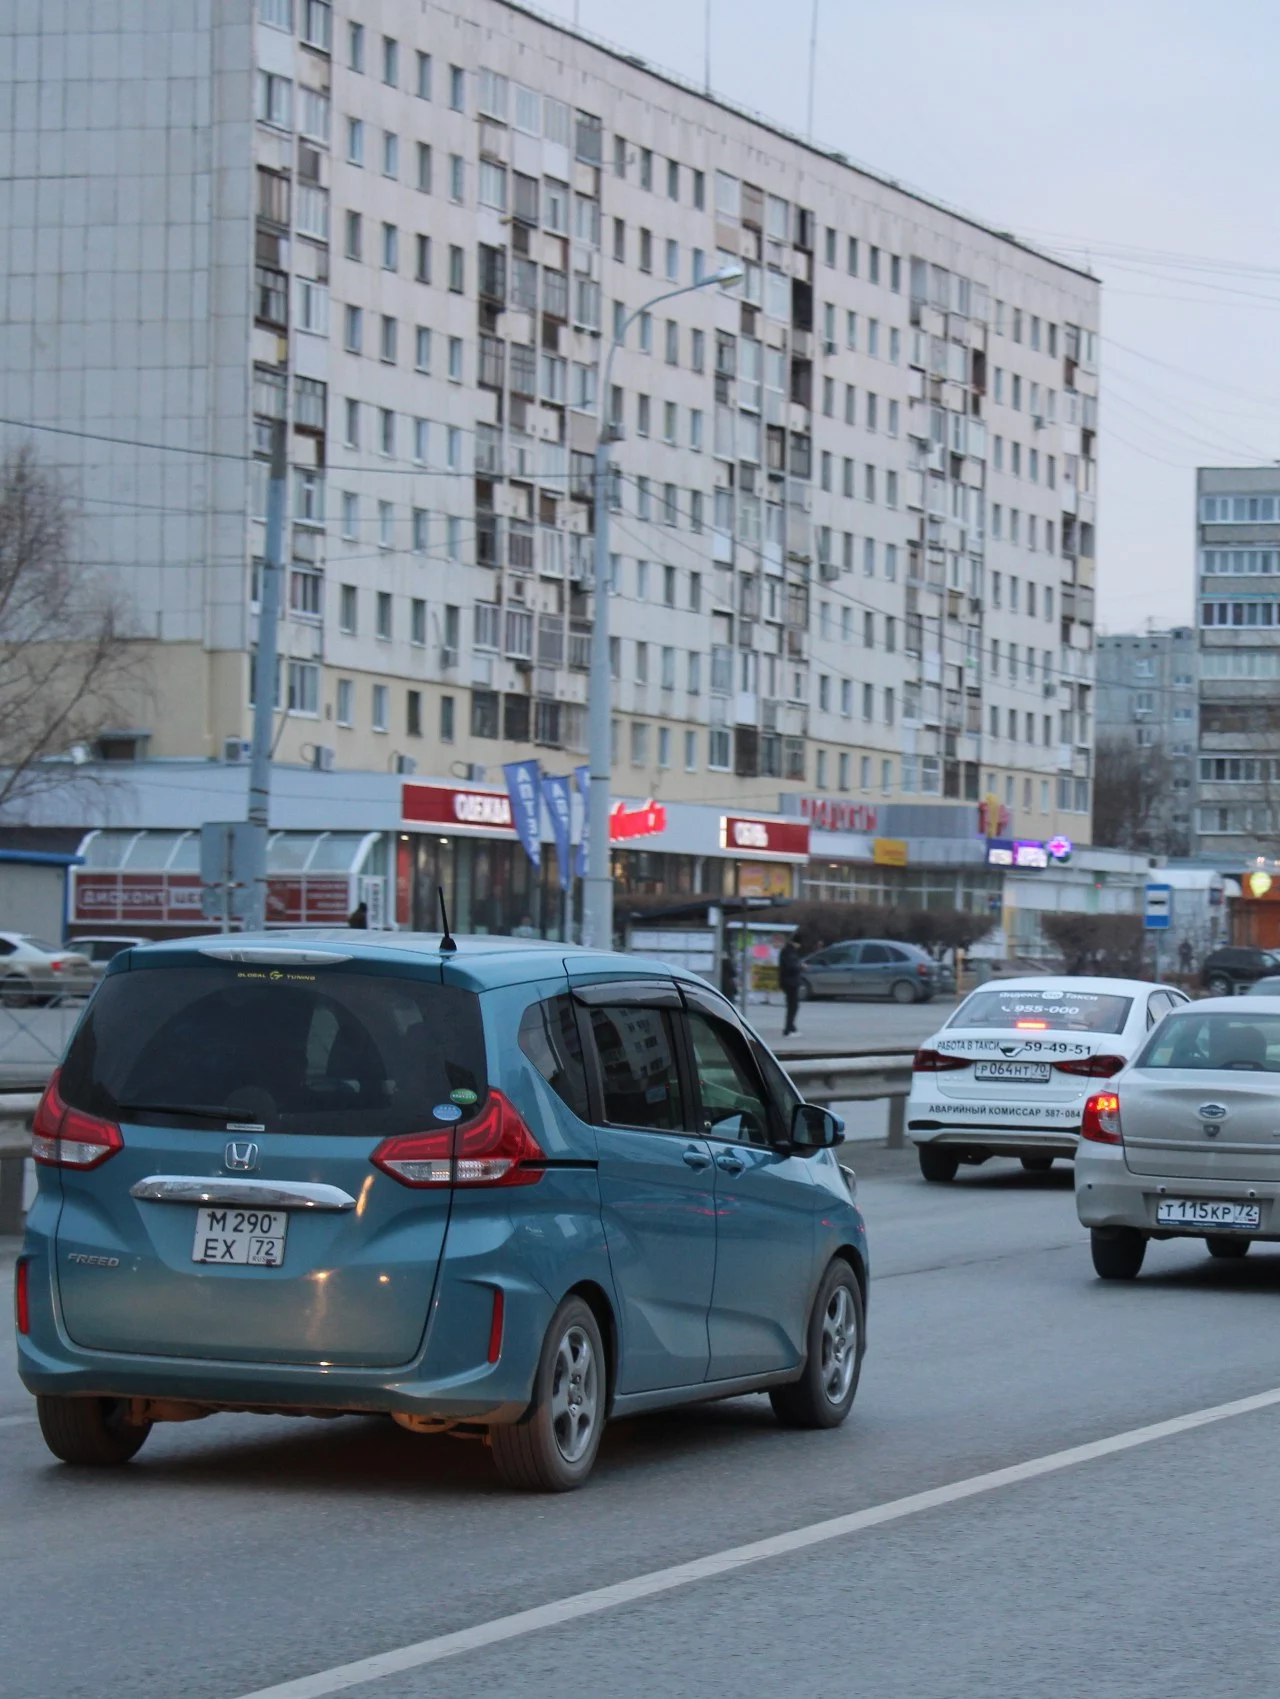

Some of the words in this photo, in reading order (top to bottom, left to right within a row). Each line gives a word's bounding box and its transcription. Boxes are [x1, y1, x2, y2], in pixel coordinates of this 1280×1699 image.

[84, 890, 165, 905] ДИСКОНТ
[1014, 1004, 1080, 1015] 955-000
[937, 1040, 967, 1050] РАБОТА
[967, 1041, 972, 1050] В
[973, 1041, 1000, 1051] ТАКСИ
[1024, 1041, 1092, 1055] 59-49-51
[929, 1104, 987, 1114] АВАРИЙНЫЙ
[988, 1106, 1041, 1117] КОМИССАР
[255, 1239, 275, 1256] 72
[67, 1253, 120, 1267] FREED
